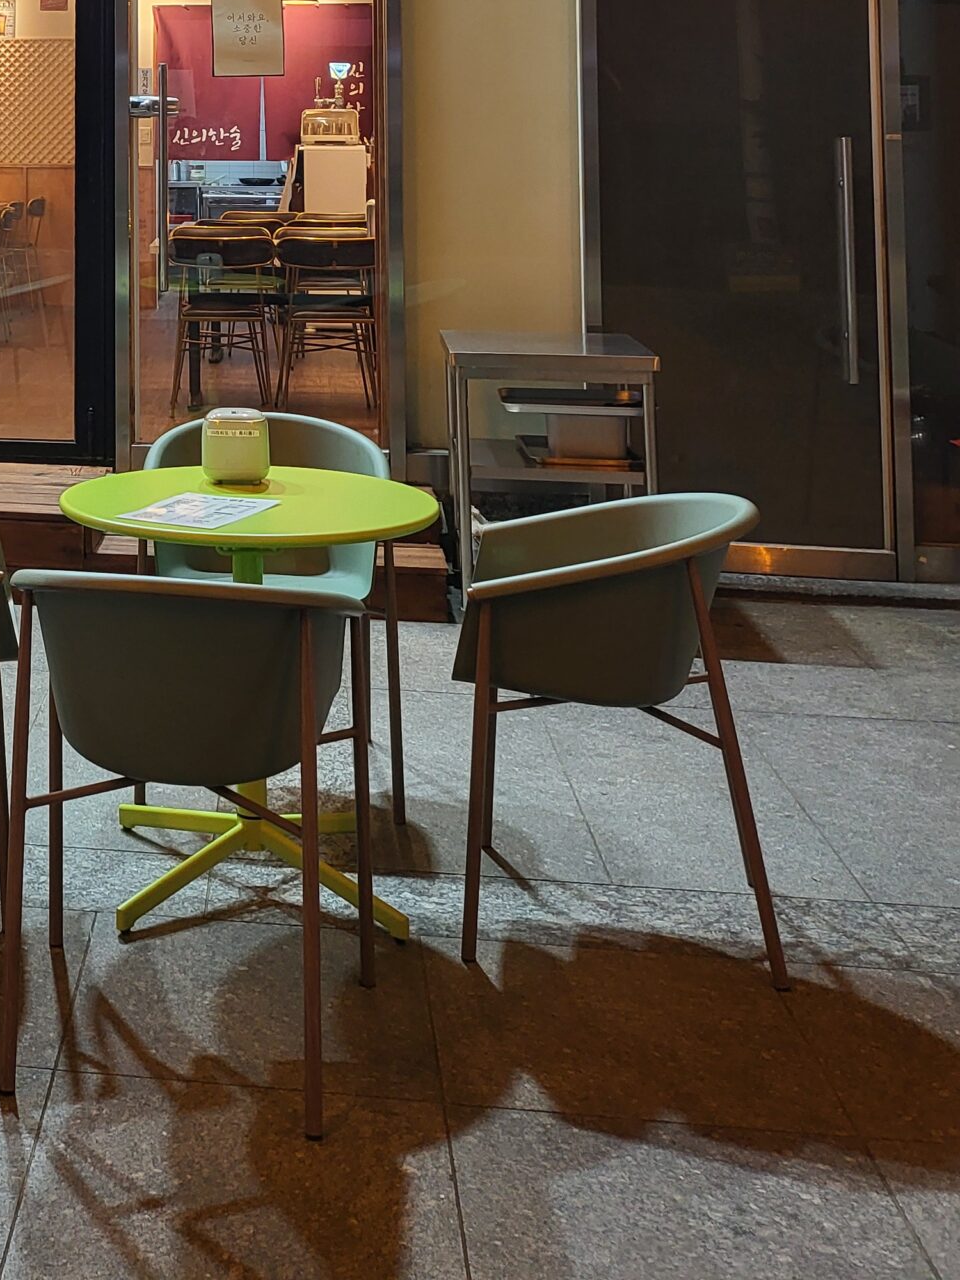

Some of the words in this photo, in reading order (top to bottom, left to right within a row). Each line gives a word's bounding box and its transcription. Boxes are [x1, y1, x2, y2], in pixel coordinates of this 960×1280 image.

[232, 23, 263, 34] 소중한
[238, 35, 257, 46] 당신
[172, 125, 242, 151] 신의한술
